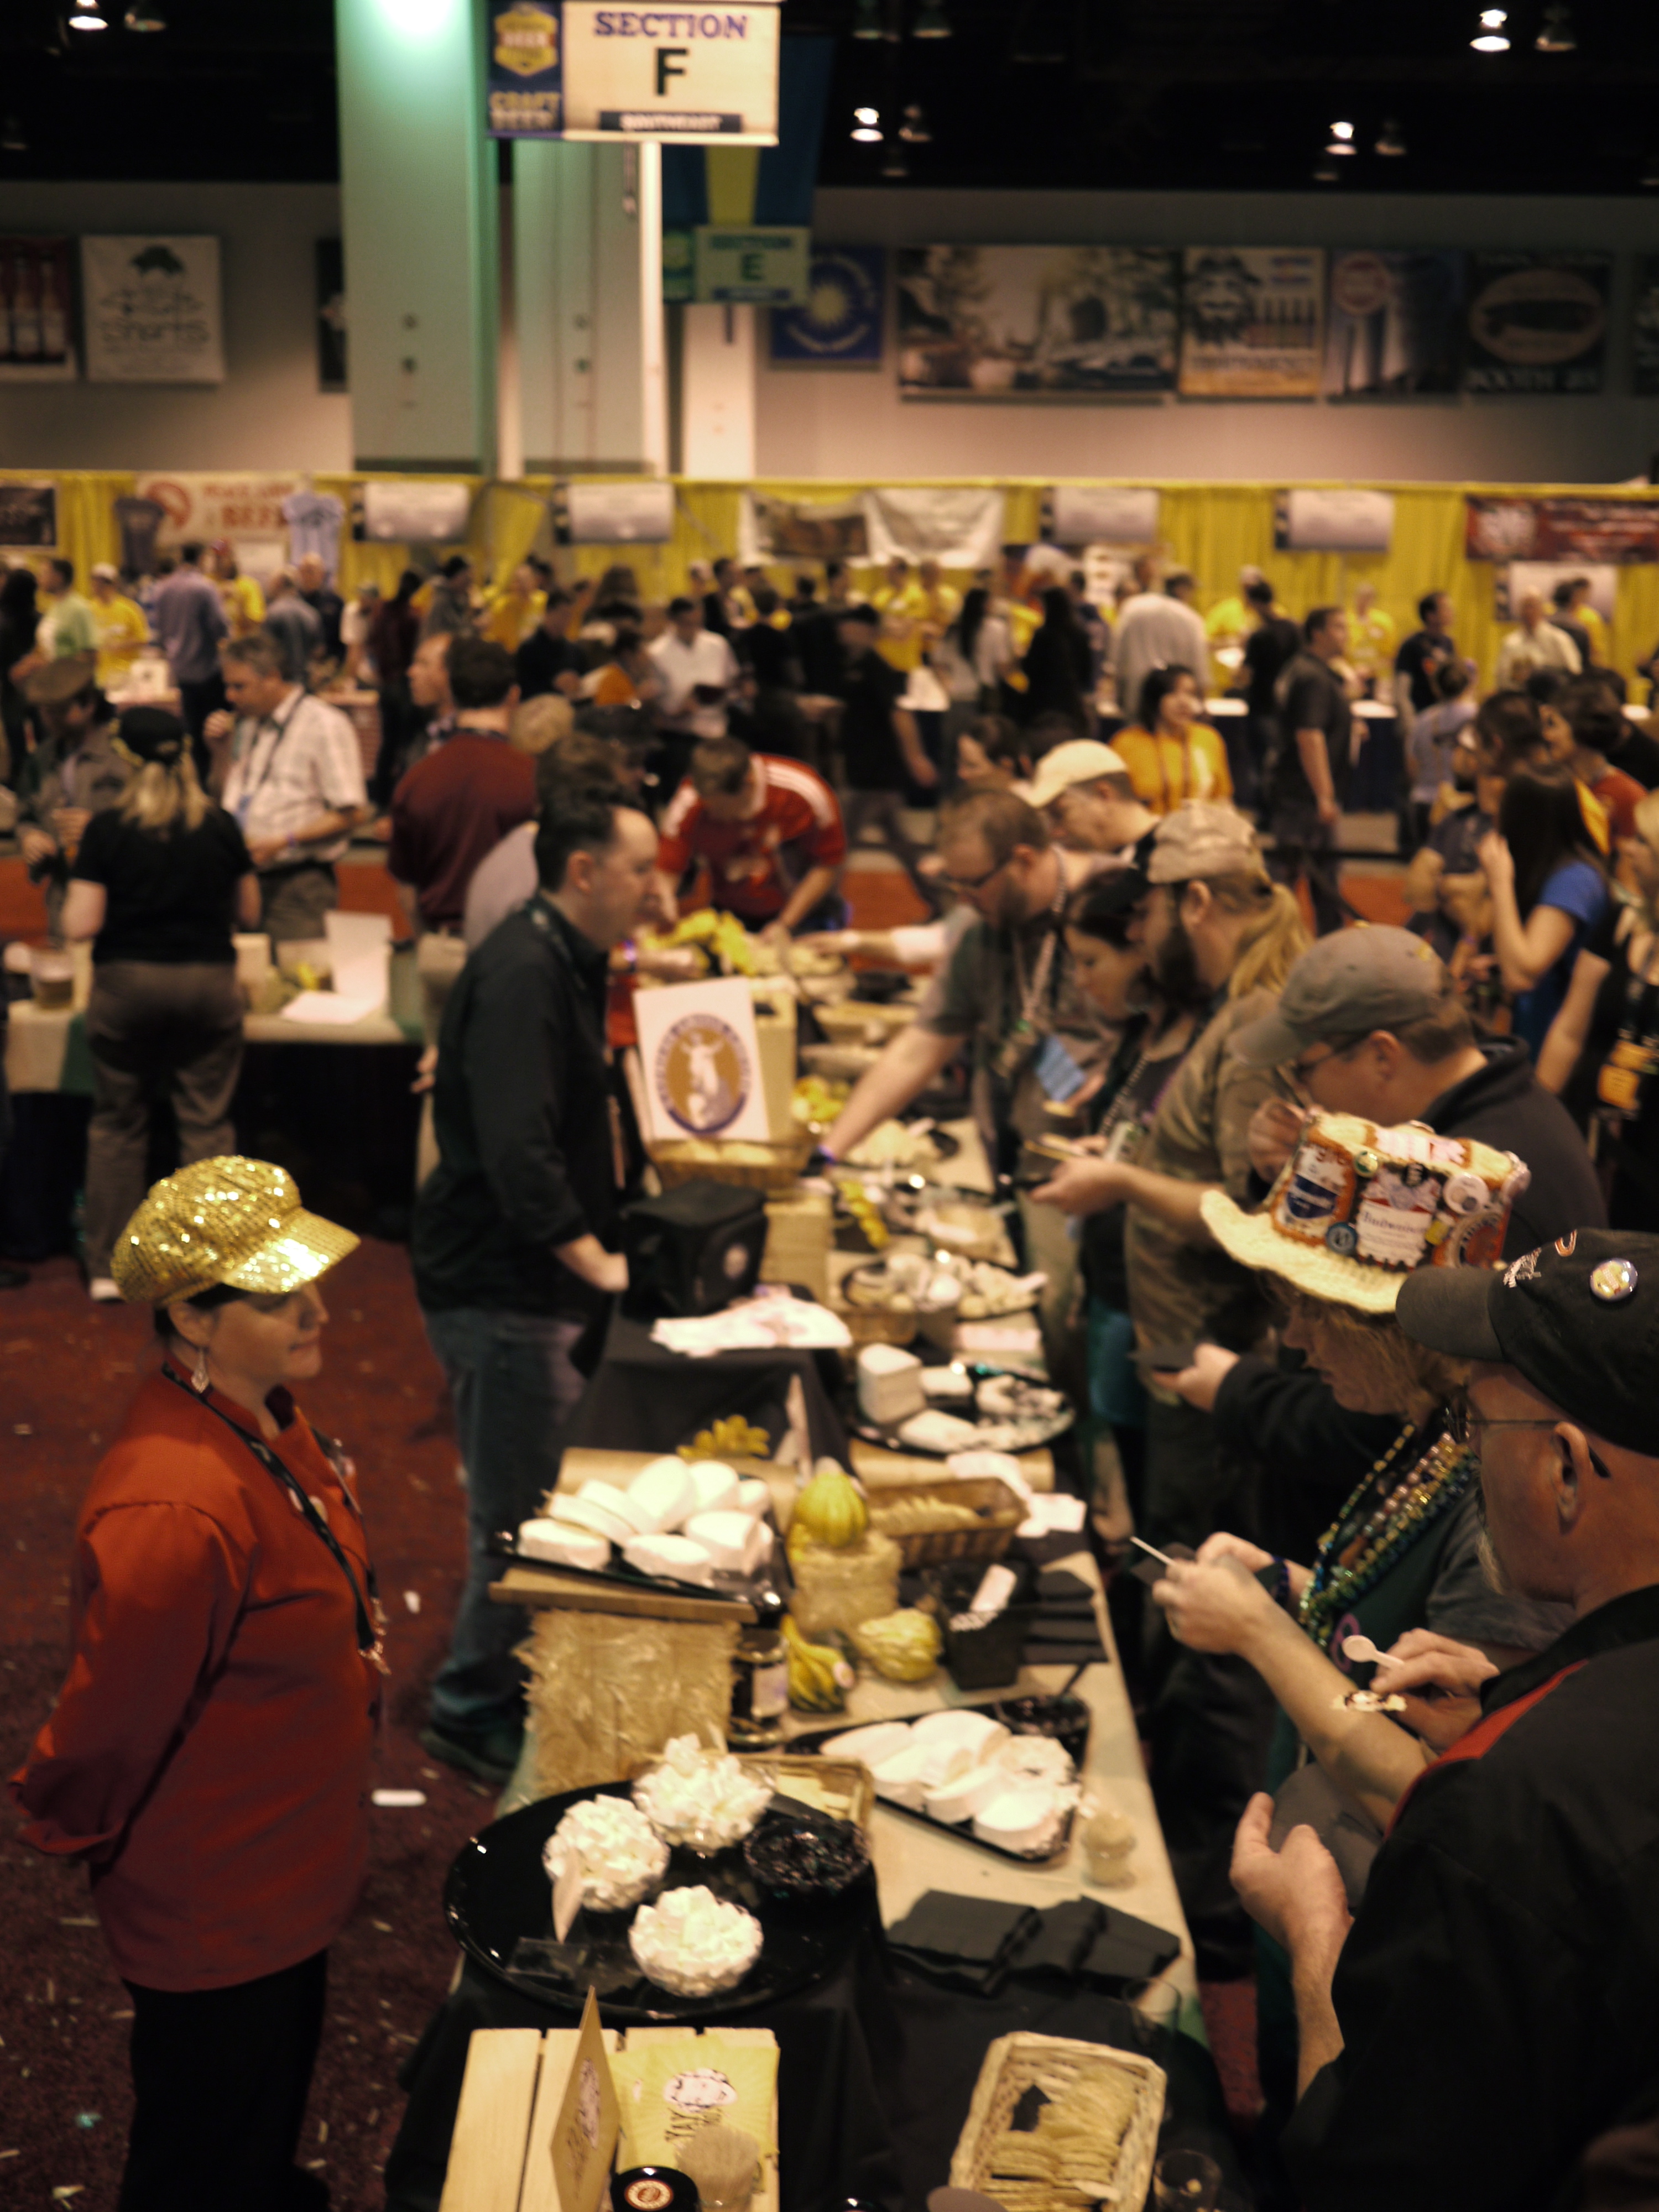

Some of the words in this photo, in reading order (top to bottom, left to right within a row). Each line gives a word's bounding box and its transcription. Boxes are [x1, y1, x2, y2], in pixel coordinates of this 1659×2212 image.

[594, 12, 748, 39] SECTION
[655, 48, 689, 96] F
[741, 253, 766, 281] E
